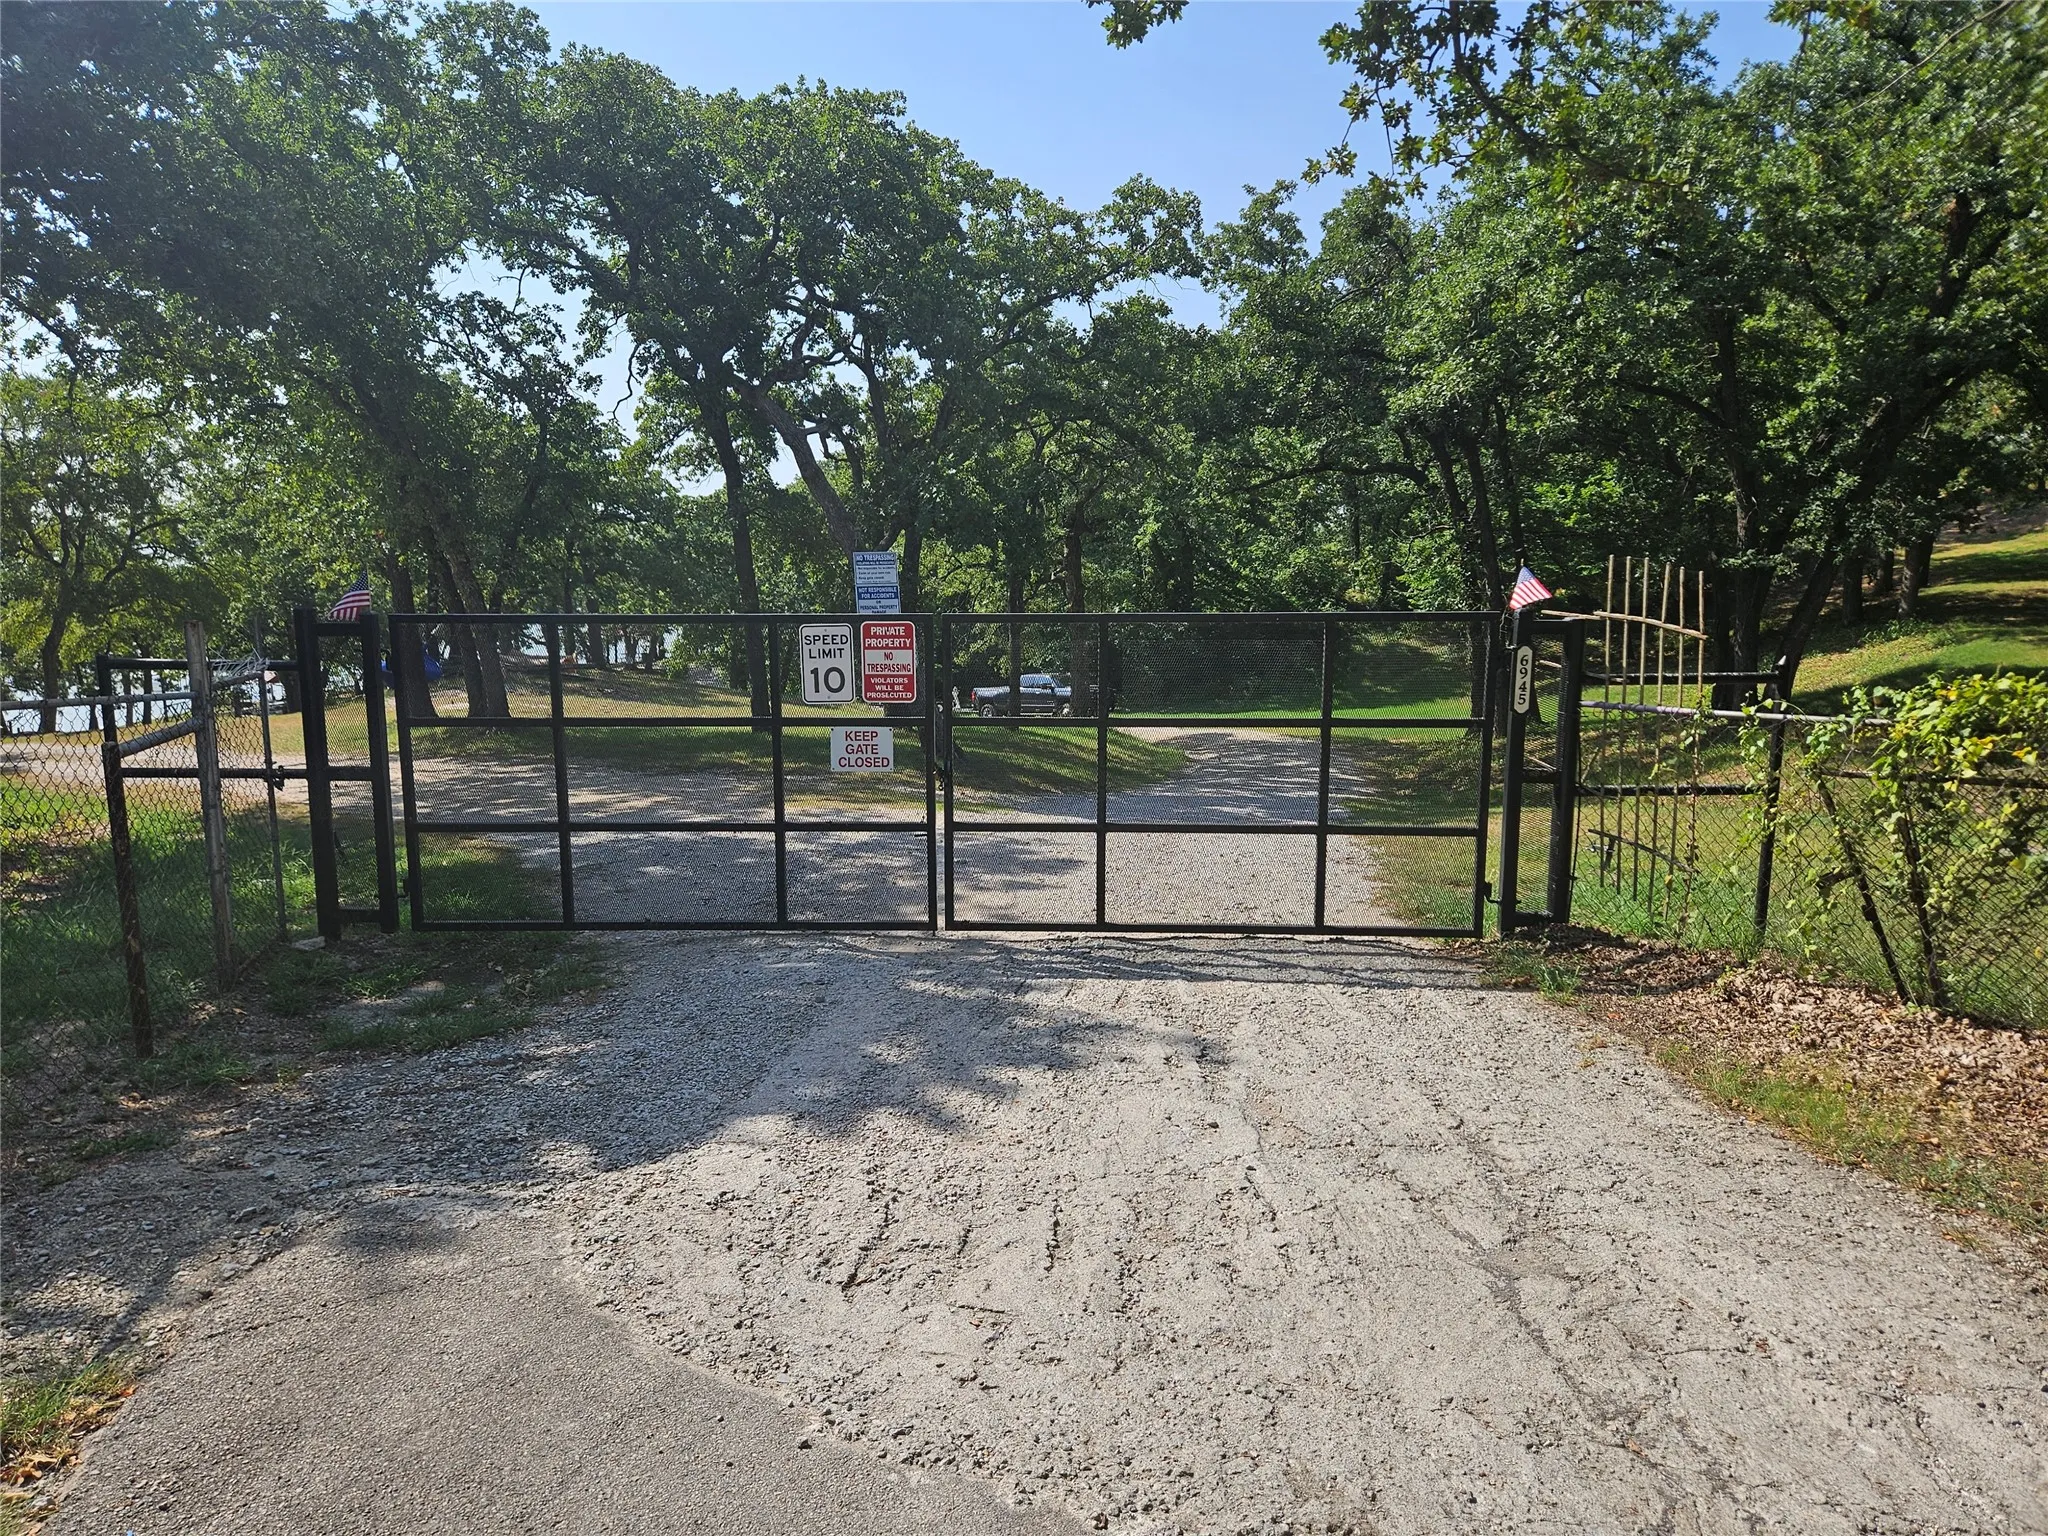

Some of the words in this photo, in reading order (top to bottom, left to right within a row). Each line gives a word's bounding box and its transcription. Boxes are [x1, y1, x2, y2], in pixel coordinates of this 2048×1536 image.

[871, 627, 905, 635] PRIVATE
[804, 635, 848, 645] SPEED
[865, 639, 911, 647] PROPERTY
[809, 648, 844, 659] LIMIT
[884, 652, 893, 660] NO
[867, 664, 911, 672] TRESPASSING
[810, 667, 845, 693] 10
[1518, 654, 1528, 705] 6945
[845, 731, 878, 741] KEEP
[845, 744, 878, 754] GATE
[838, 757, 890, 768] CLOSED
